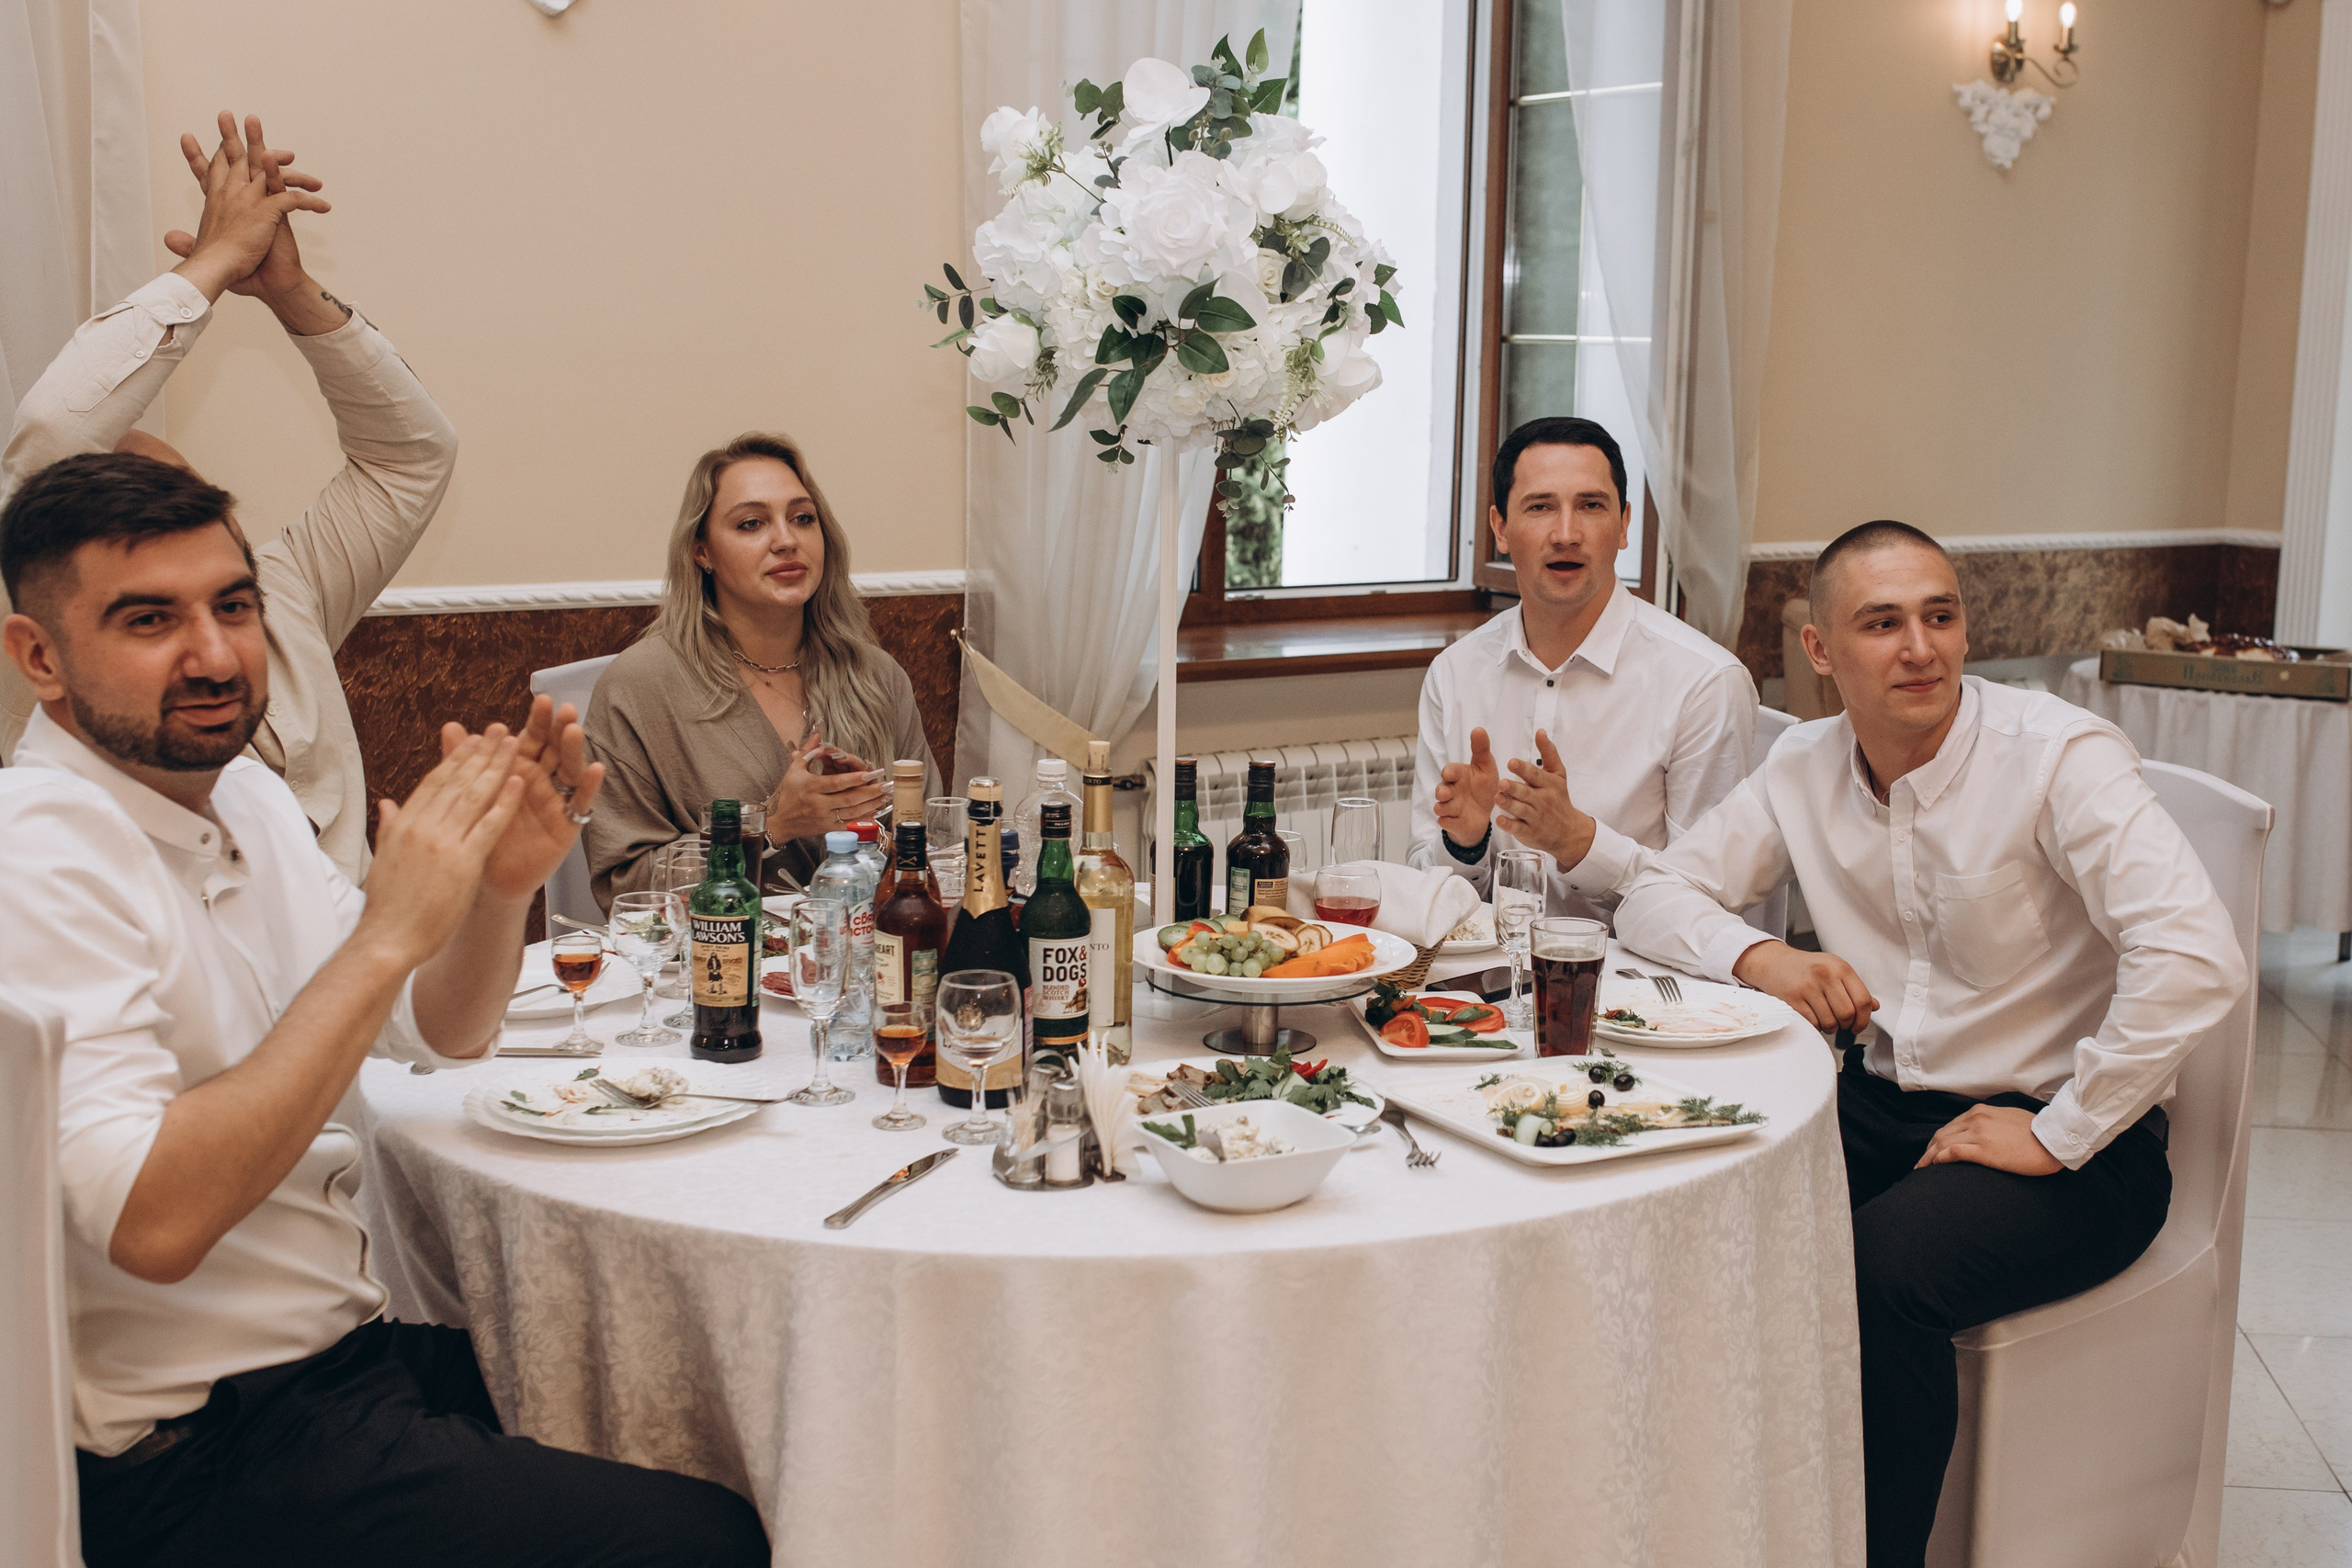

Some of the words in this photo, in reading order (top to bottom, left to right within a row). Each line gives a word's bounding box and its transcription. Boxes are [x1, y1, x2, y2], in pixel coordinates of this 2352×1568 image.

[692, 919, 741, 932] WILLIAM
[692, 929, 745, 943] LAWSON'S
[1043, 963, 1087, 983] DOGS
